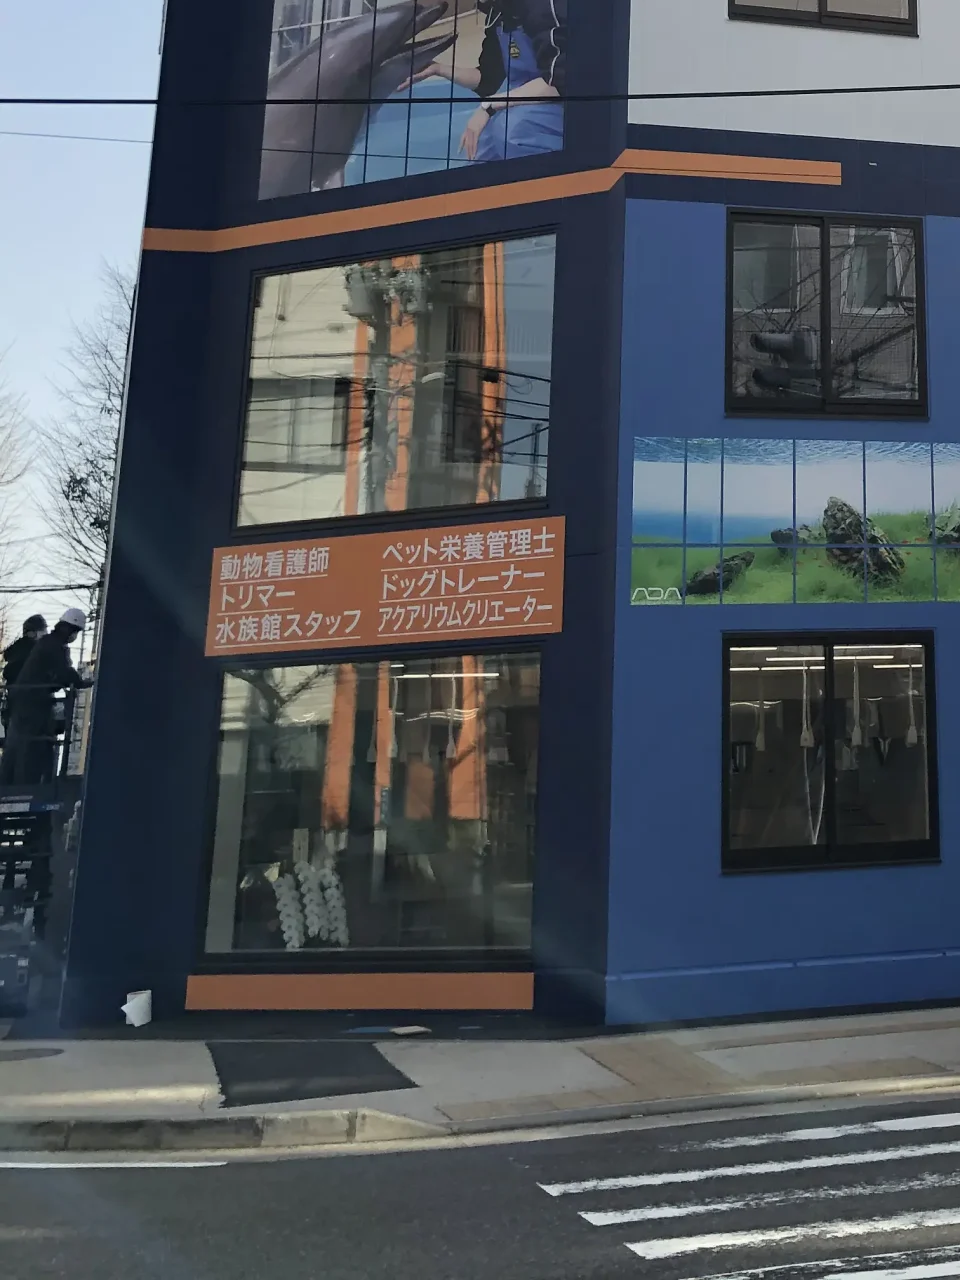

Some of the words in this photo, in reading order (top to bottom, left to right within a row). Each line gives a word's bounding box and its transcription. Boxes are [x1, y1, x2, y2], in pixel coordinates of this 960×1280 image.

[382, 526, 556, 564] ペット栄養管理士
[220, 546, 330, 581] 動物看護師
[221, 585, 296, 611] トリマー
[381, 564, 546, 600] ドッグトレーナー
[215, 609, 361, 644] 水族館スタッフ
[377, 595, 553, 633] アクアリウムクリエーター
